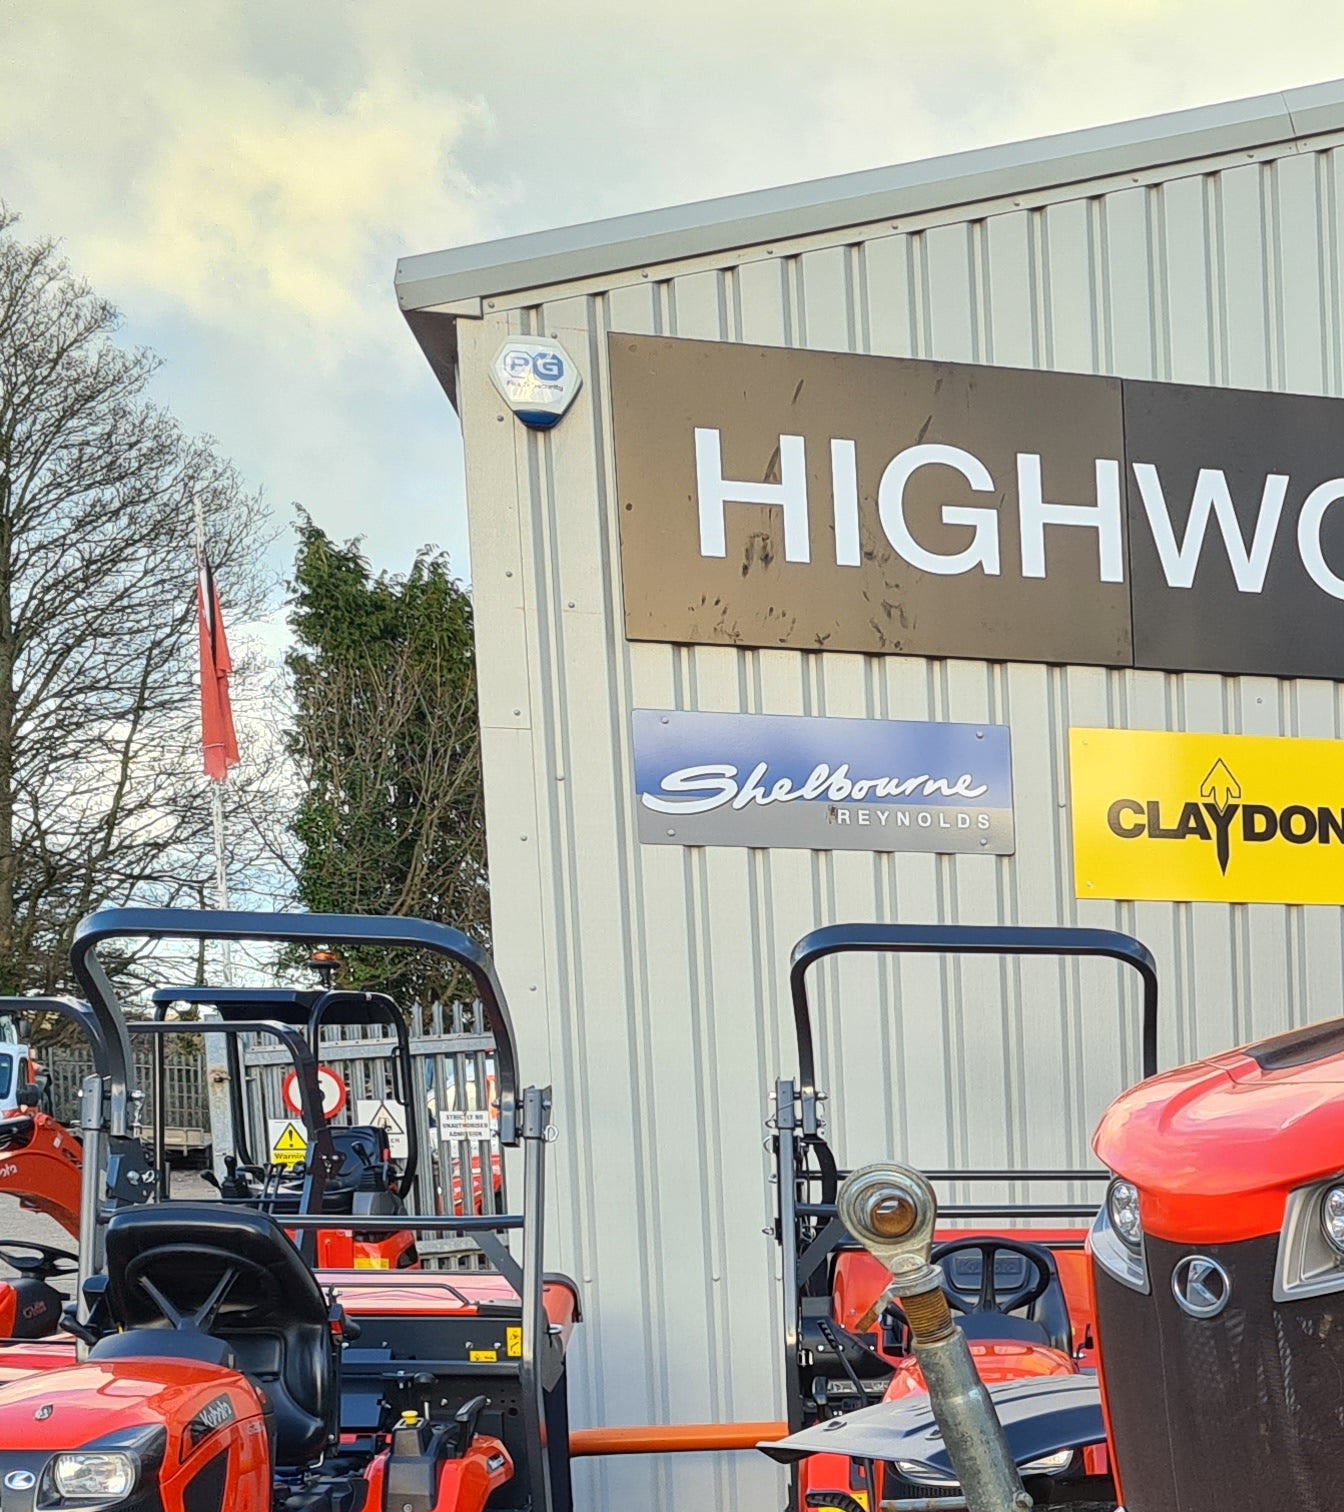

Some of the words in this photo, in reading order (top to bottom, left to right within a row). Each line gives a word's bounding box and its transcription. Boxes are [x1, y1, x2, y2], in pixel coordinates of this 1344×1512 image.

[642, 762, 988, 815] Shelbourne
[837, 809, 990, 829] REYNOLDS
[199, 1400, 232, 1428] Kubota
